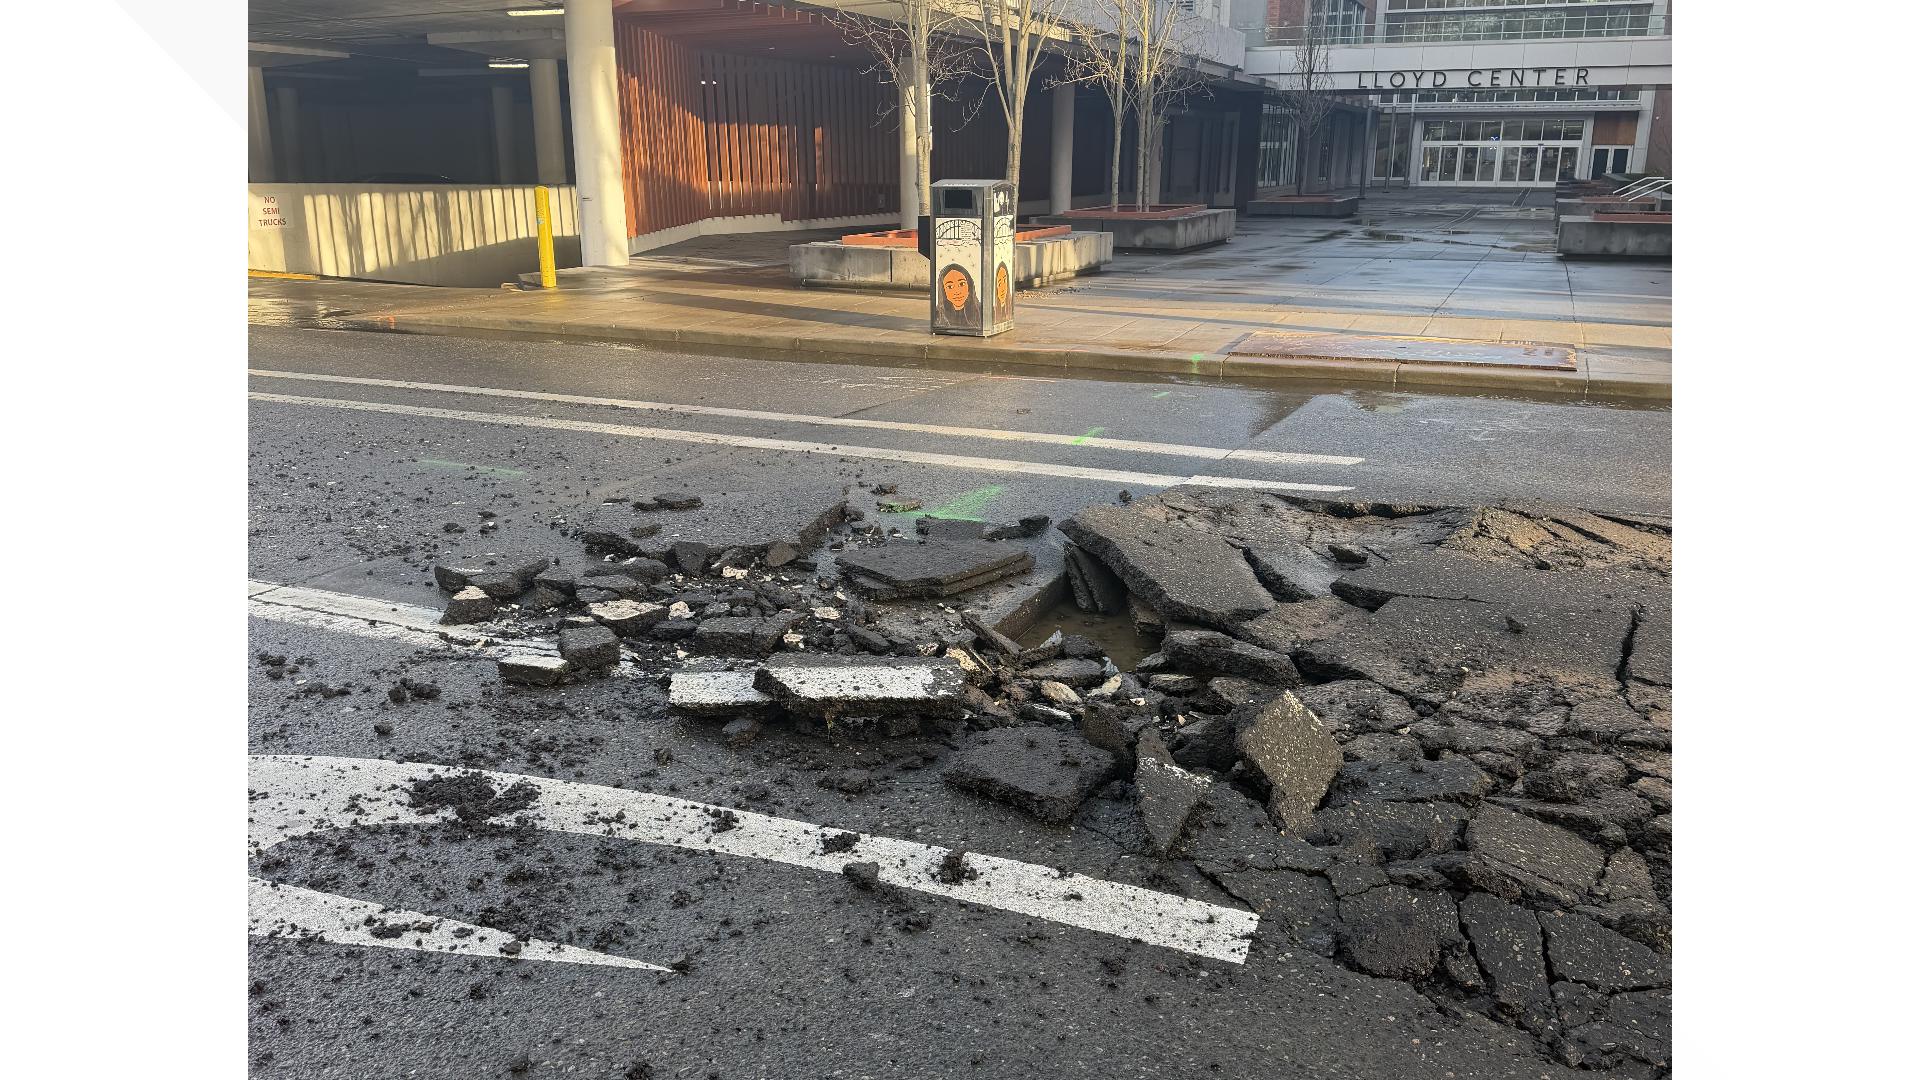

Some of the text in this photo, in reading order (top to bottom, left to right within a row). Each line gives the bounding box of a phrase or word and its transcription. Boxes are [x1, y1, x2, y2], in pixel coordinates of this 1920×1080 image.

[1358, 68, 1589, 89] LLOYD CENTER
[264, 196, 276, 204] NO
[262, 207, 280, 215] SEMI
[258, 218, 287, 227] TRUCKS
